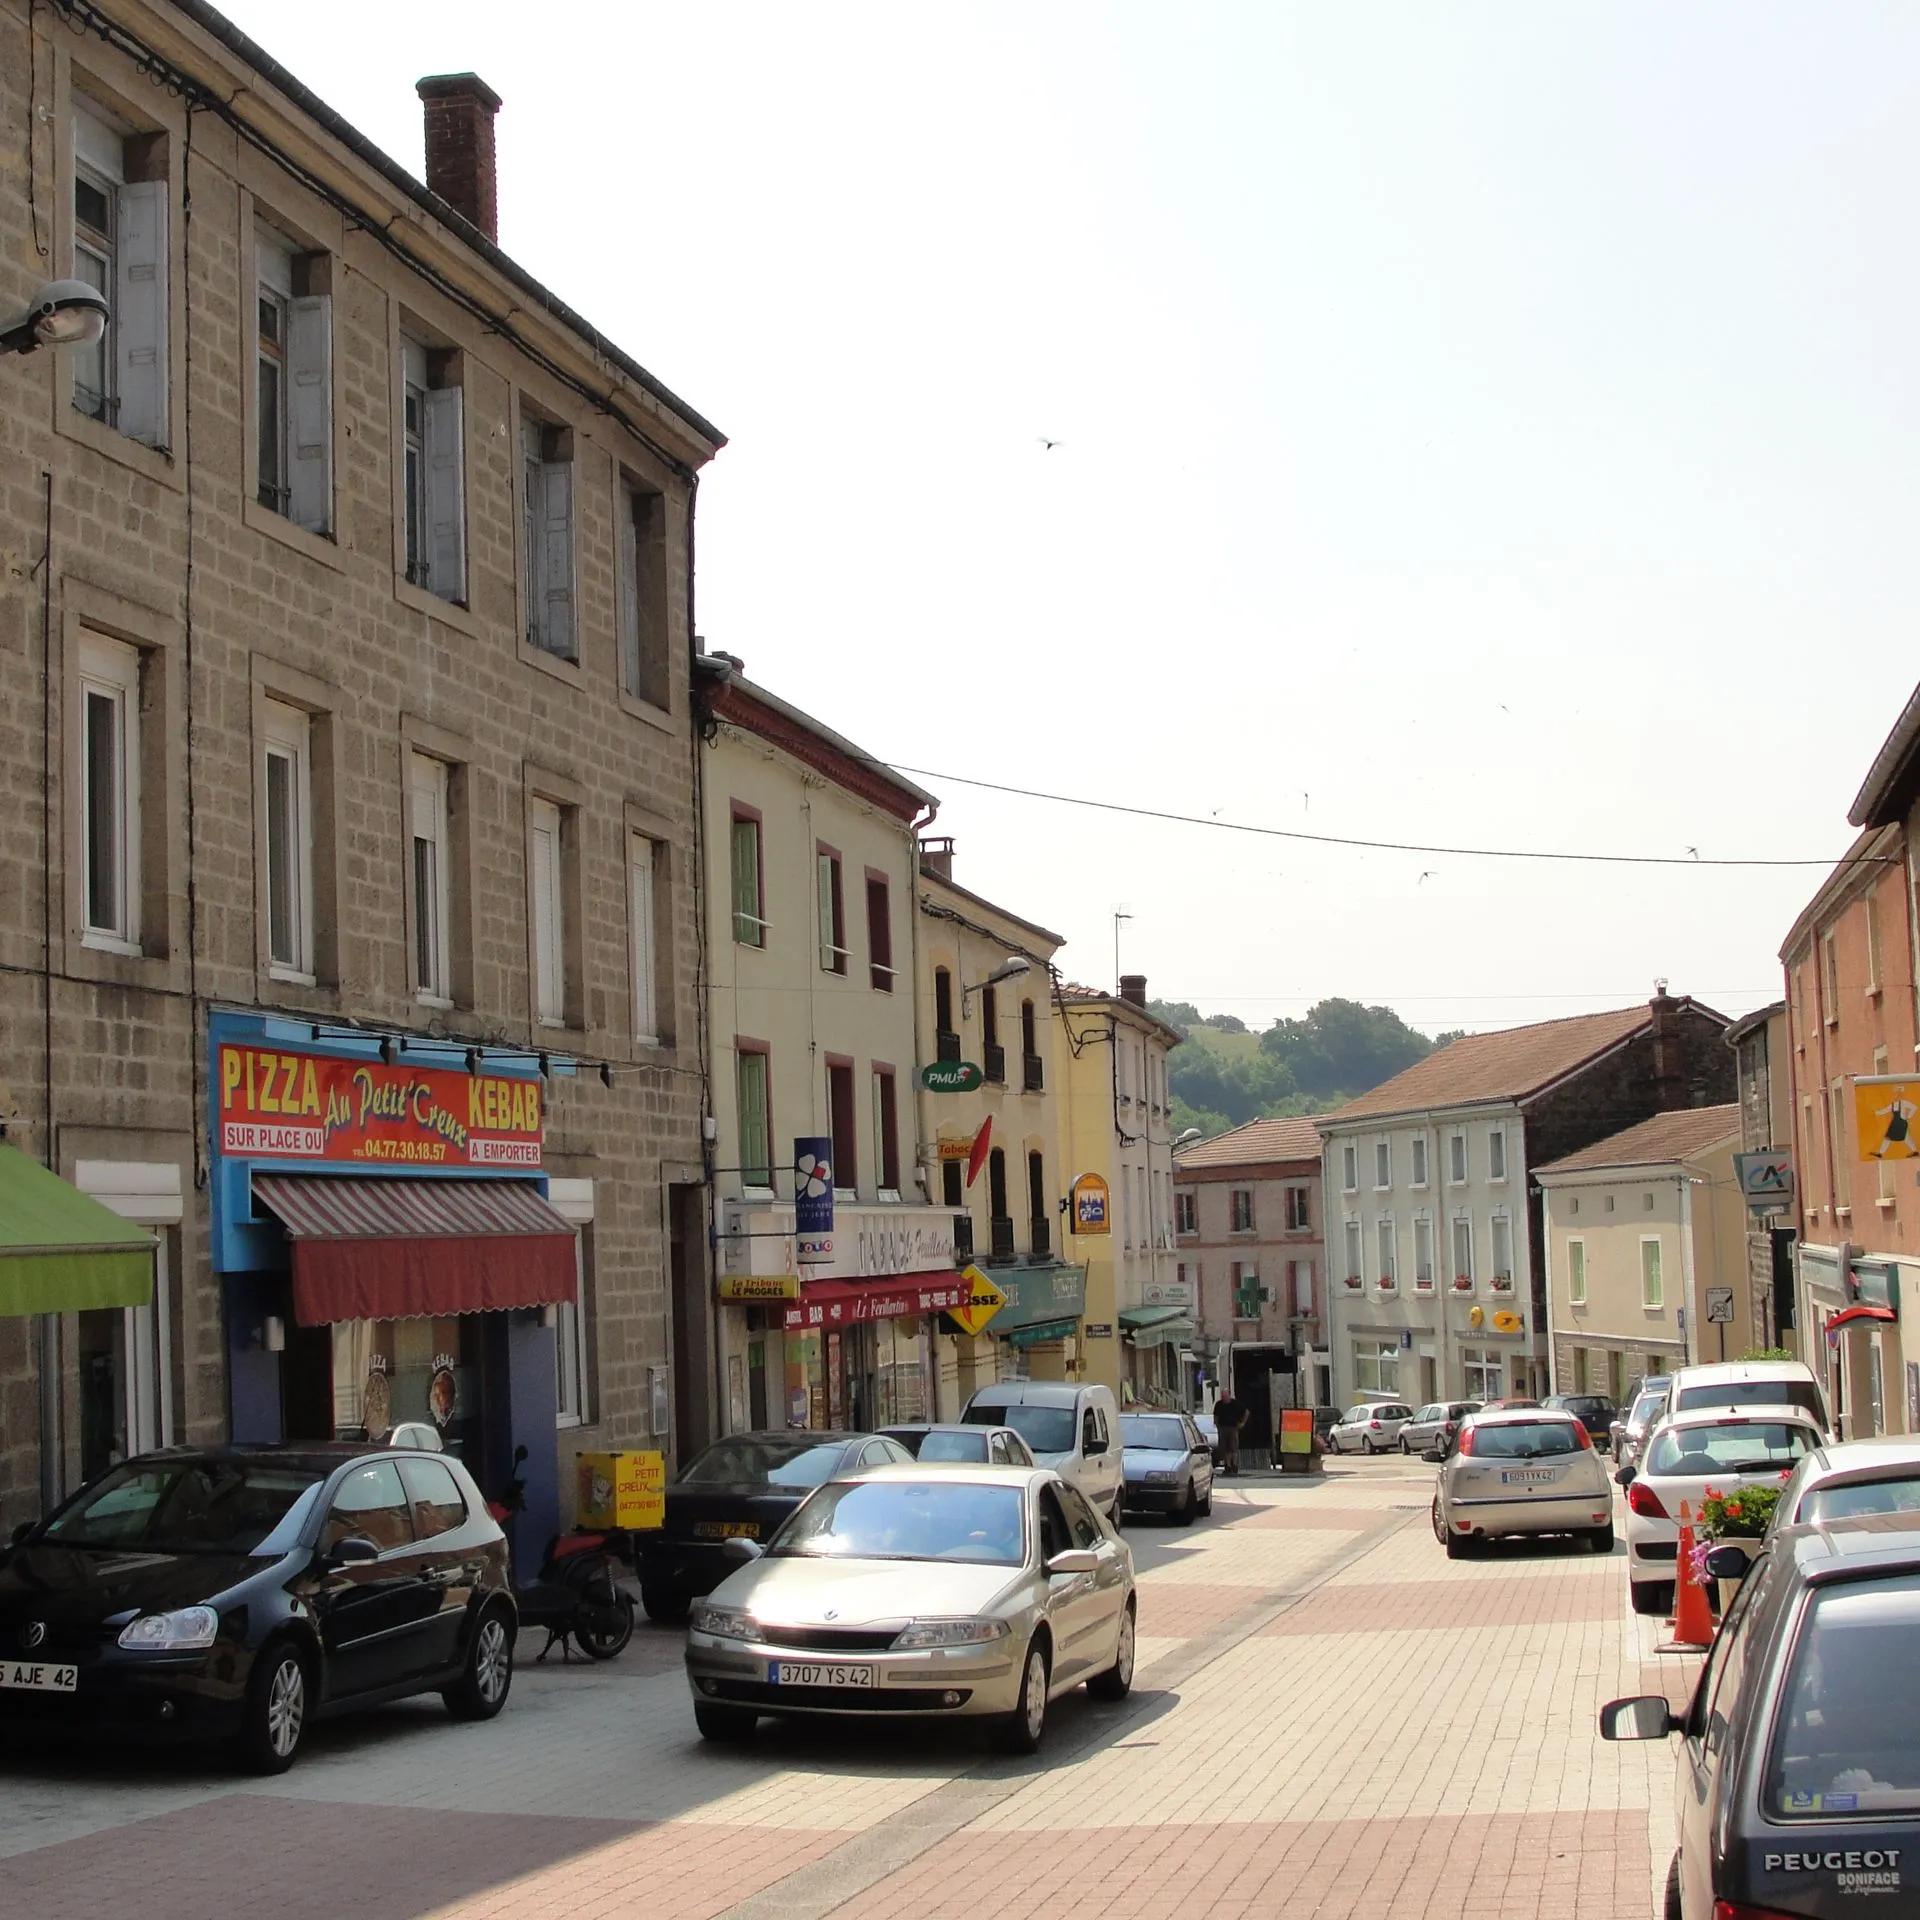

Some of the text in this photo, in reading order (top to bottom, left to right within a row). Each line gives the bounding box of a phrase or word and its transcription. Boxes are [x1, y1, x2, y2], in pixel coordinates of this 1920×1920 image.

[223, 1049, 321, 1116] PIZZA
[928, 1072, 957, 1084] PMU
[468, 1078, 539, 1132] KEBAB
[323, 1083, 351, 1141] Au
[413, 1084, 468, 1149] Creux
[227, 1126, 322, 1150] SUR PLACE OU
[366, 1139, 446, 1161] 04.77.30.18.57
[471, 1142, 539, 1162] A EMPORTER
[939, 1144, 969, 1155] Tabac
[809, 1305, 823, 1324] BAR
[632, 1456, 645, 1466] AU
[635, 1468, 660, 1479] PETIT
[618, 1482, 650, 1493] CREUX
[13, 1666, 44, 1684] AJE
[54, 1668, 75, 1687] 42
[781, 1666, 869, 1685] 3707 YS 42
[1764, 1850, 1900, 1871] PEUGEOT
[1837, 1872, 1900, 1886] BONIFACE
